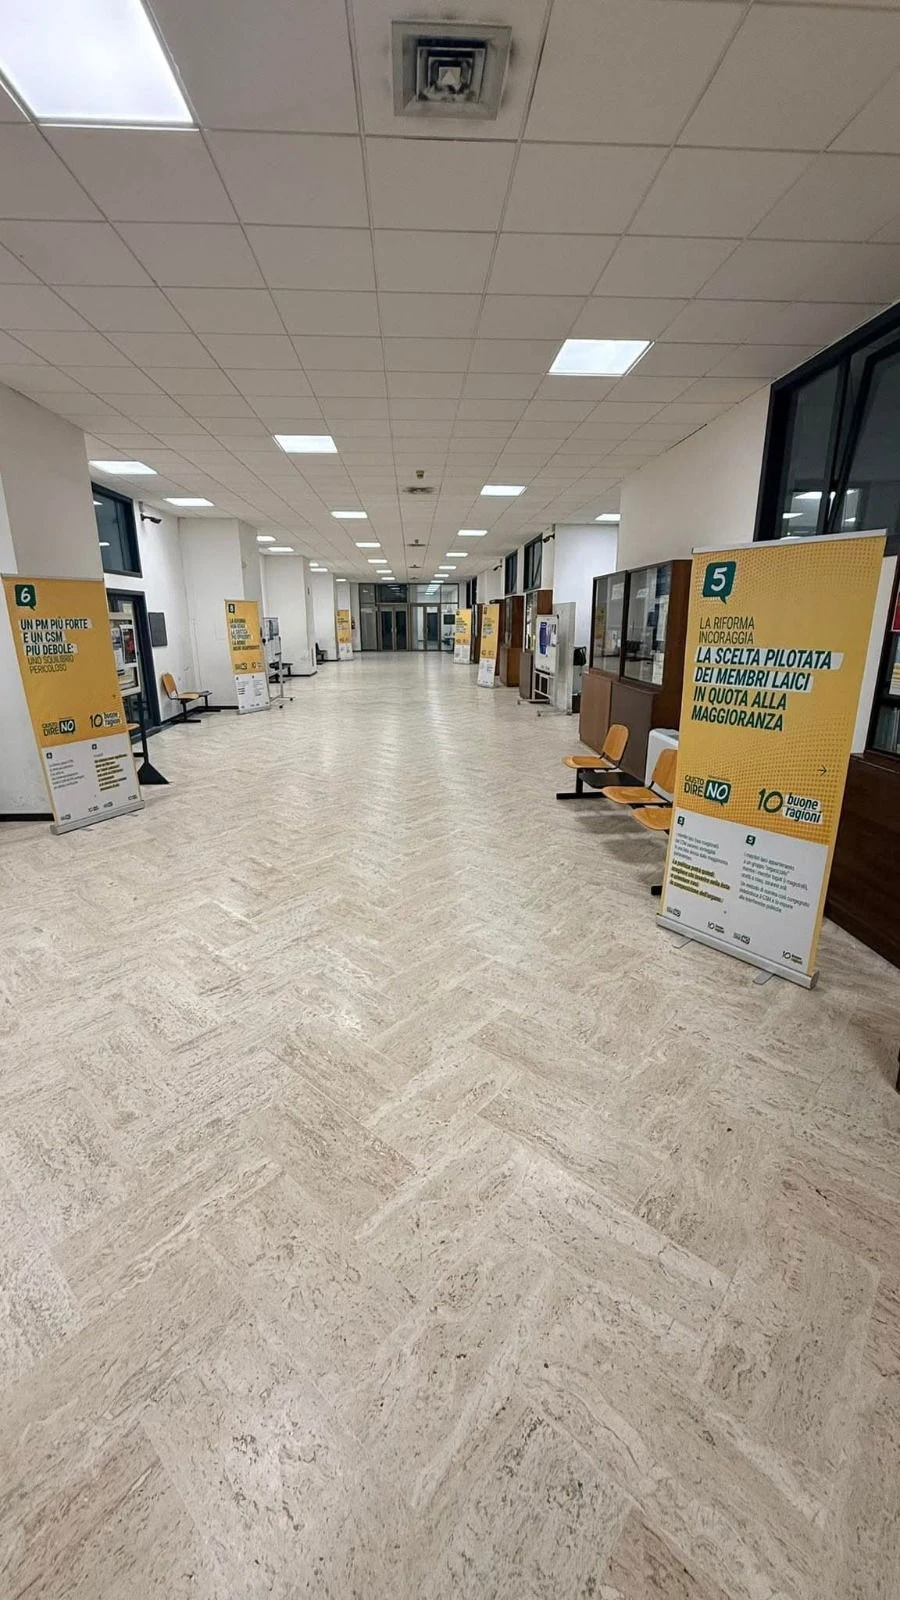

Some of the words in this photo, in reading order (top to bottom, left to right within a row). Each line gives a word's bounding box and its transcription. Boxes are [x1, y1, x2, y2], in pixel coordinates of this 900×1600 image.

[710, 567, 726, 592] 5
[20, 587, 31, 603] 6
[20, 618, 33, 630] UN
[36, 619, 48, 630] PM
[50, 616, 64, 630] PIÙ
[65, 618, 88, 630] FORTE
[700, 616, 711, 630] LA
[713, 616, 755, 630] RIFORMA
[23, 632, 28, 643] E
[30, 632, 42, 642] UN
[45, 631, 63, 642] CSM
[698, 631, 754, 644] INCORAGGIA
[26, 643, 40, 656] PIÙ
[43, 644, 74, 655] DEBOLE:
[28, 657, 42, 665] UNO
[44, 655, 74, 664] SQUILIBRIO
[696, 647, 711, 664] LA
[715, 648, 760, 666] SCELTA
[765, 649, 832, 669] PILOTATA
[30, 664, 67, 674] PERICOLOSO
[694, 667, 712, 684] DEI
[716, 668, 770, 688] MEMBRI
[771, 671, 811, 691] LAICI
[693, 686, 706, 702] IN
[708, 688, 748, 708] QUOTA
[752, 691, 788, 710] ALLA
[89, 714, 103, 728] 10
[691, 705, 784, 732] MAGGIORANZA
[43, 727, 60, 736] DIRE
[60, 720, 74, 732] NO
[684, 784, 704, 798] DIRE
[705, 784, 728, 801] NO
[758, 788, 784, 814] 10
[787, 794, 818, 811] buone
[785, 806, 822, 823] ragioni
